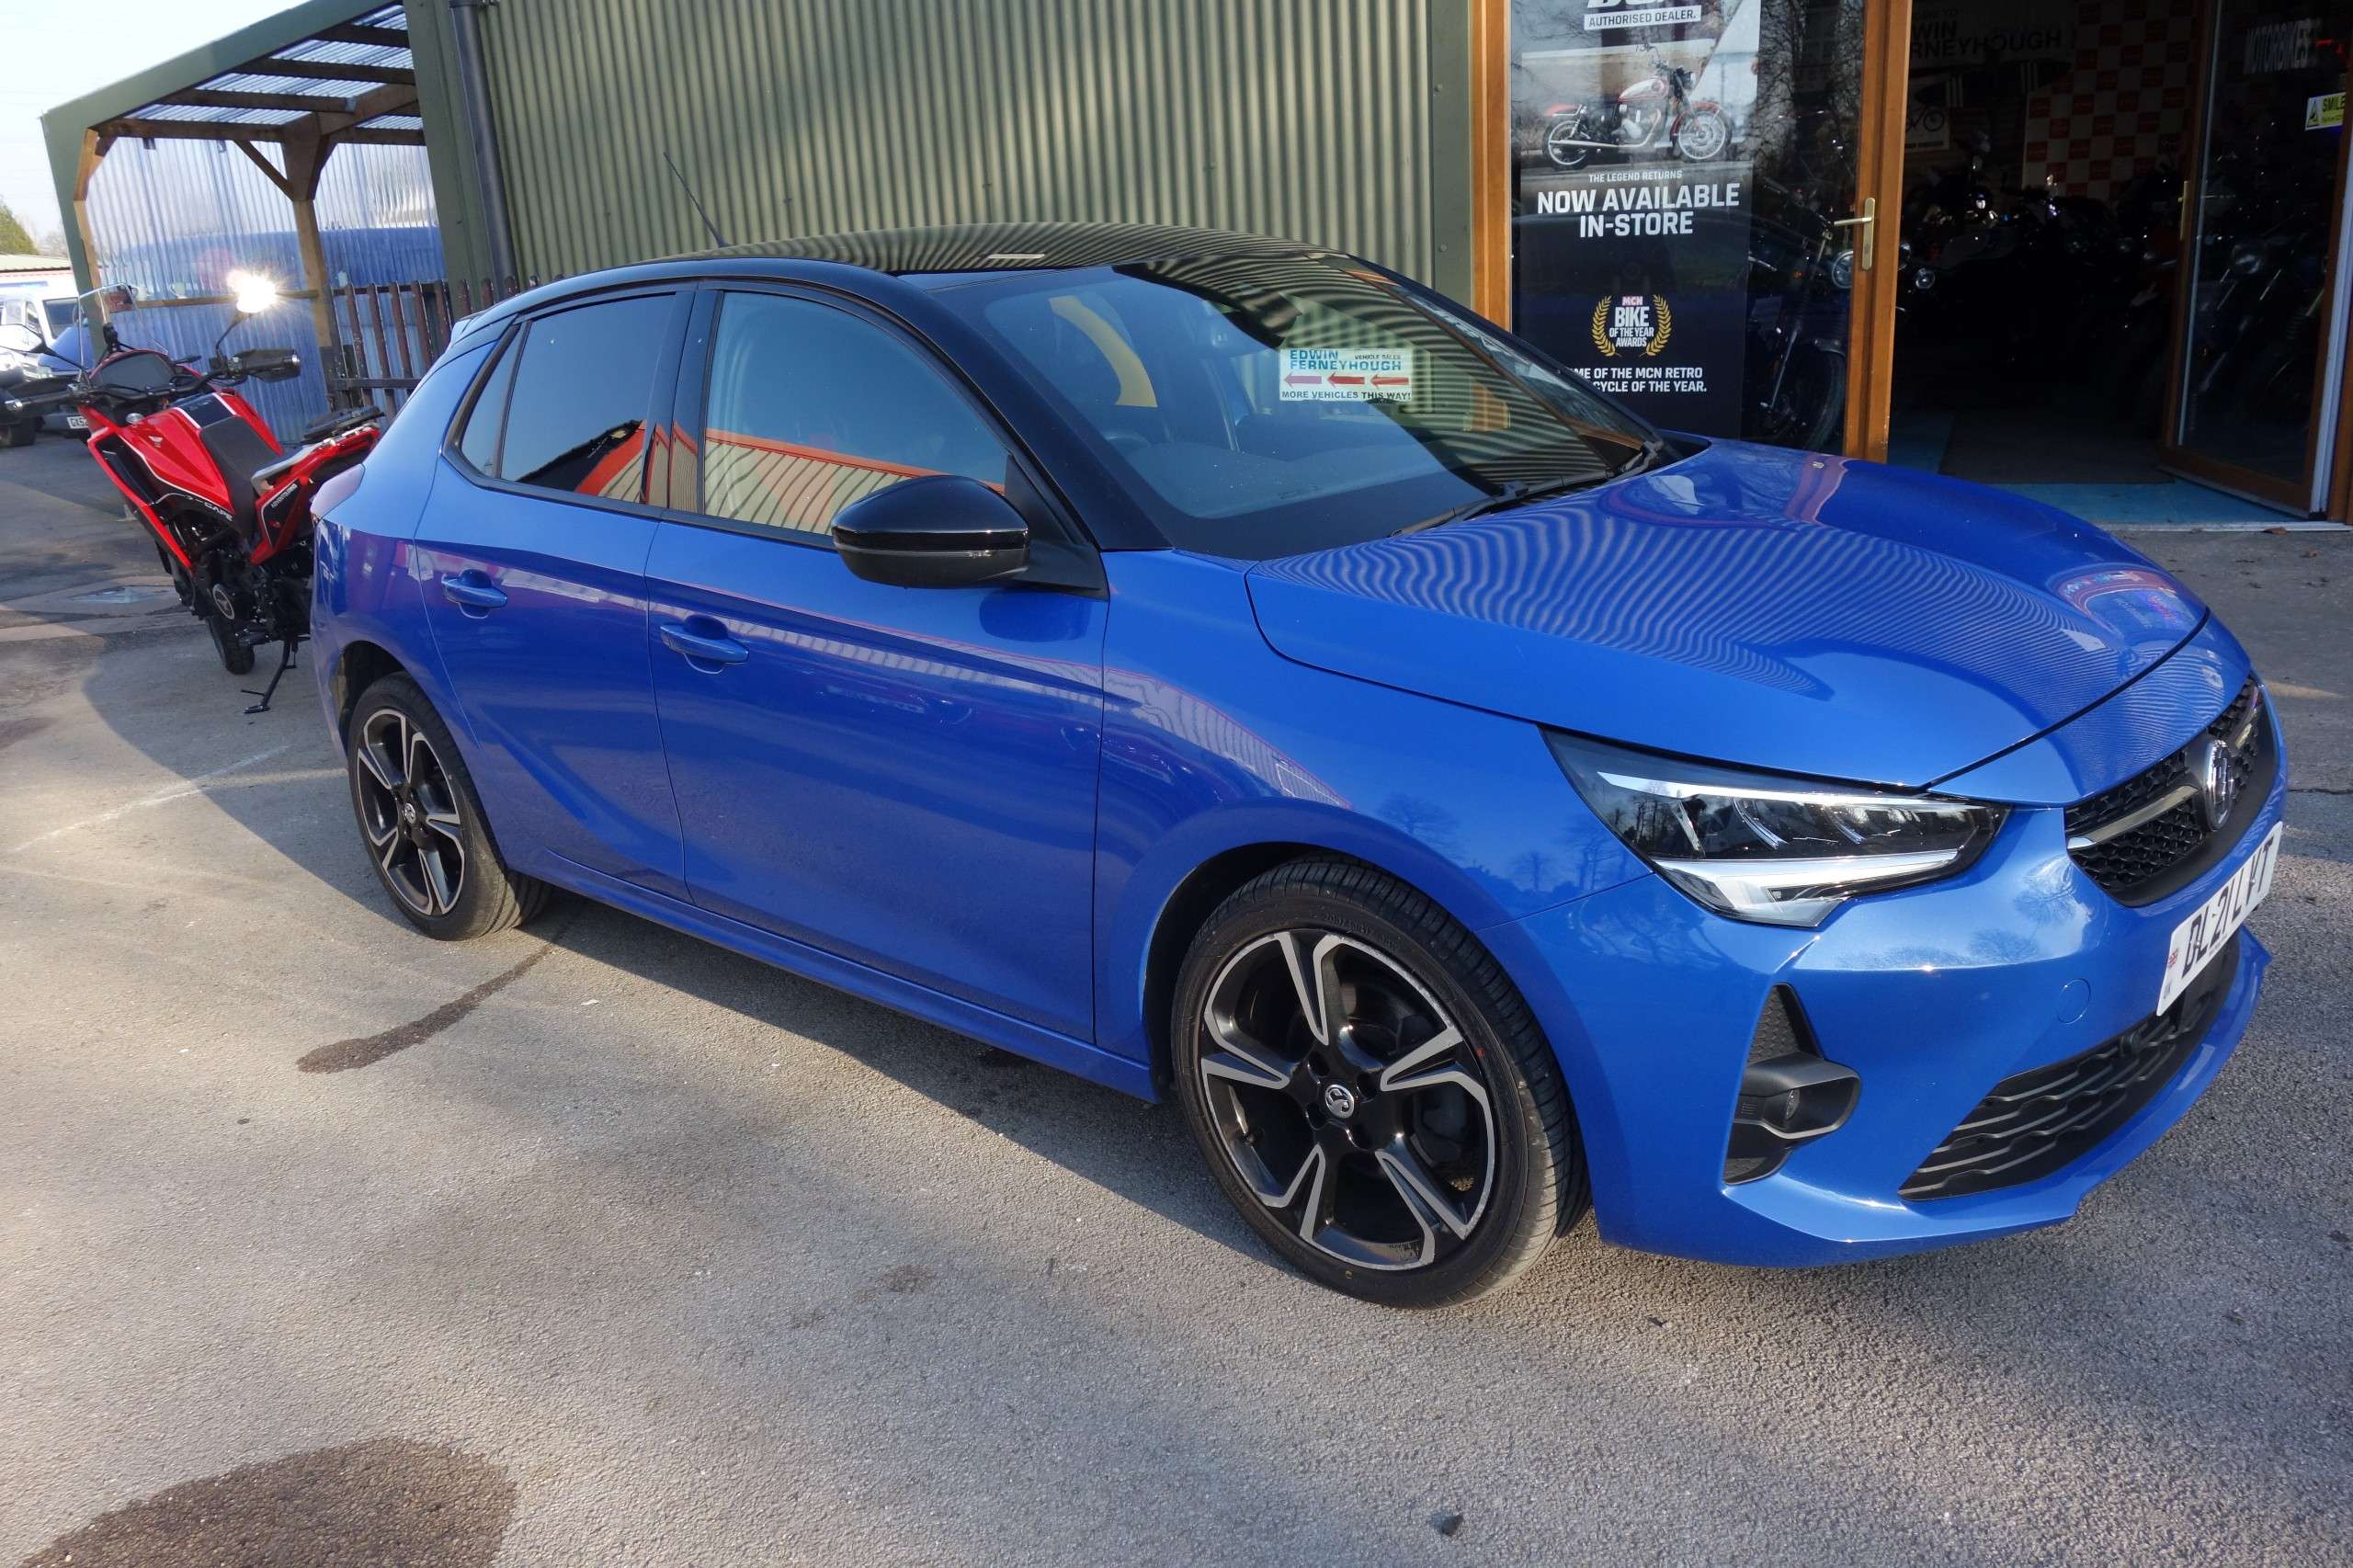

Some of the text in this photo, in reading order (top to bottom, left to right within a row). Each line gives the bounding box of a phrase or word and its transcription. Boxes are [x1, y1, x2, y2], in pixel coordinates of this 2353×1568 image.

[1588, 9, 1697, 27] AUTHORISED DEALER.
[1911, 29, 2063, 59] RNEYHOUGH
[1588, 170, 1683, 183] THE LEGEND RETURNS
[1538, 183, 1741, 214] NOW AVAILABLE
[1580, 211, 1694, 238] IN-STORE
[1622, 296, 1643, 306] MCN
[1615, 306, 1649, 328] BIKE
[1609, 327, 1654, 338] OF THE YEAR
[1616, 337, 1647, 347] AWARDS
[1290, 349, 1339, 360] EDWIN
[1290, 359, 1402, 371] FERNEYHOUGH
[1571, 367, 1703, 380] ME OF THE MCN RETRO
[1595, 381, 1707, 392] CYCLE OF THE YEAR.
[1281, 391, 1412, 401] MORE VEHICLES THIS WAY!
